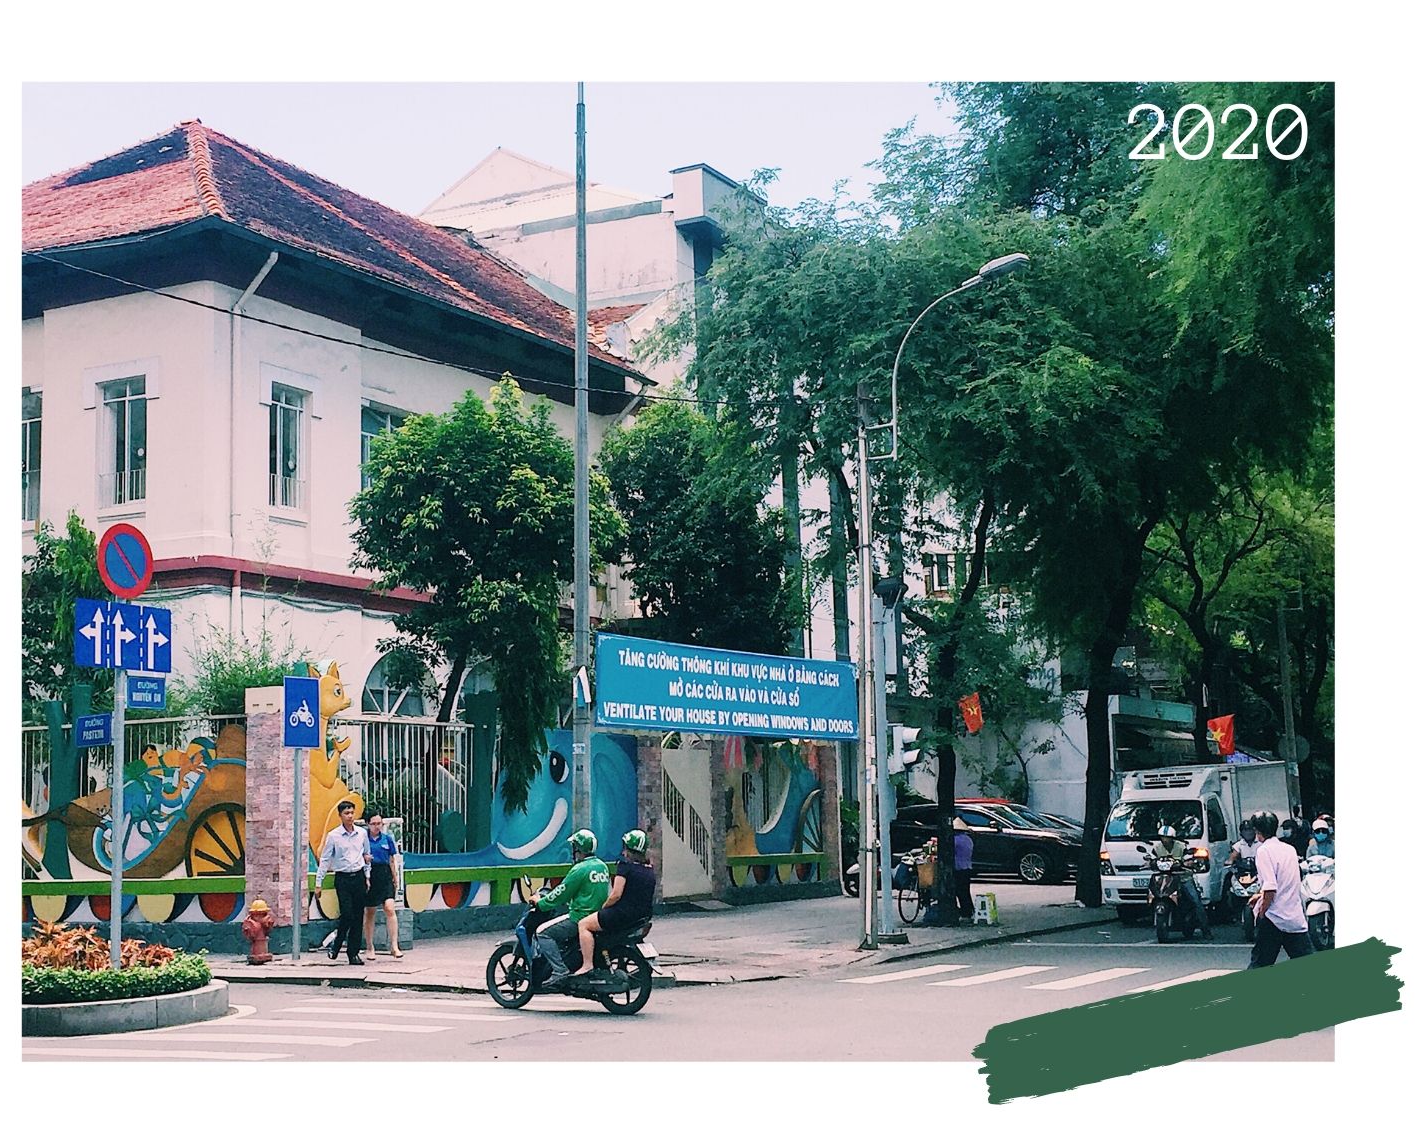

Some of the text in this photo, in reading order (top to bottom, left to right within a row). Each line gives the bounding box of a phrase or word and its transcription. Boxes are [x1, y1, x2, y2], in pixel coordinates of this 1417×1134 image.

[618, 648, 645, 668] TĂNG
[647, 650, 680, 671] CƯỜNG
[681, 655, 712, 675] THÔNG
[714, 658, 730, 676] KHÍ
[731, 662, 750, 679] KHU
[751, 663, 768, 683] VỰC
[769, 664, 786, 682] NHÀ
[795, 665, 817, 685] BẰNG
[818, 669, 840, 687] CÁCH
[669, 676, 800, 707] MỞ CÁC CỬA RA VÀO VÀ CỬA SỔ
[603, 701, 854, 734] VENTILATE YOUR HOUSE BY OPENING WINDOWS AND DOORS
[589, 869, 609, 883] Grab
